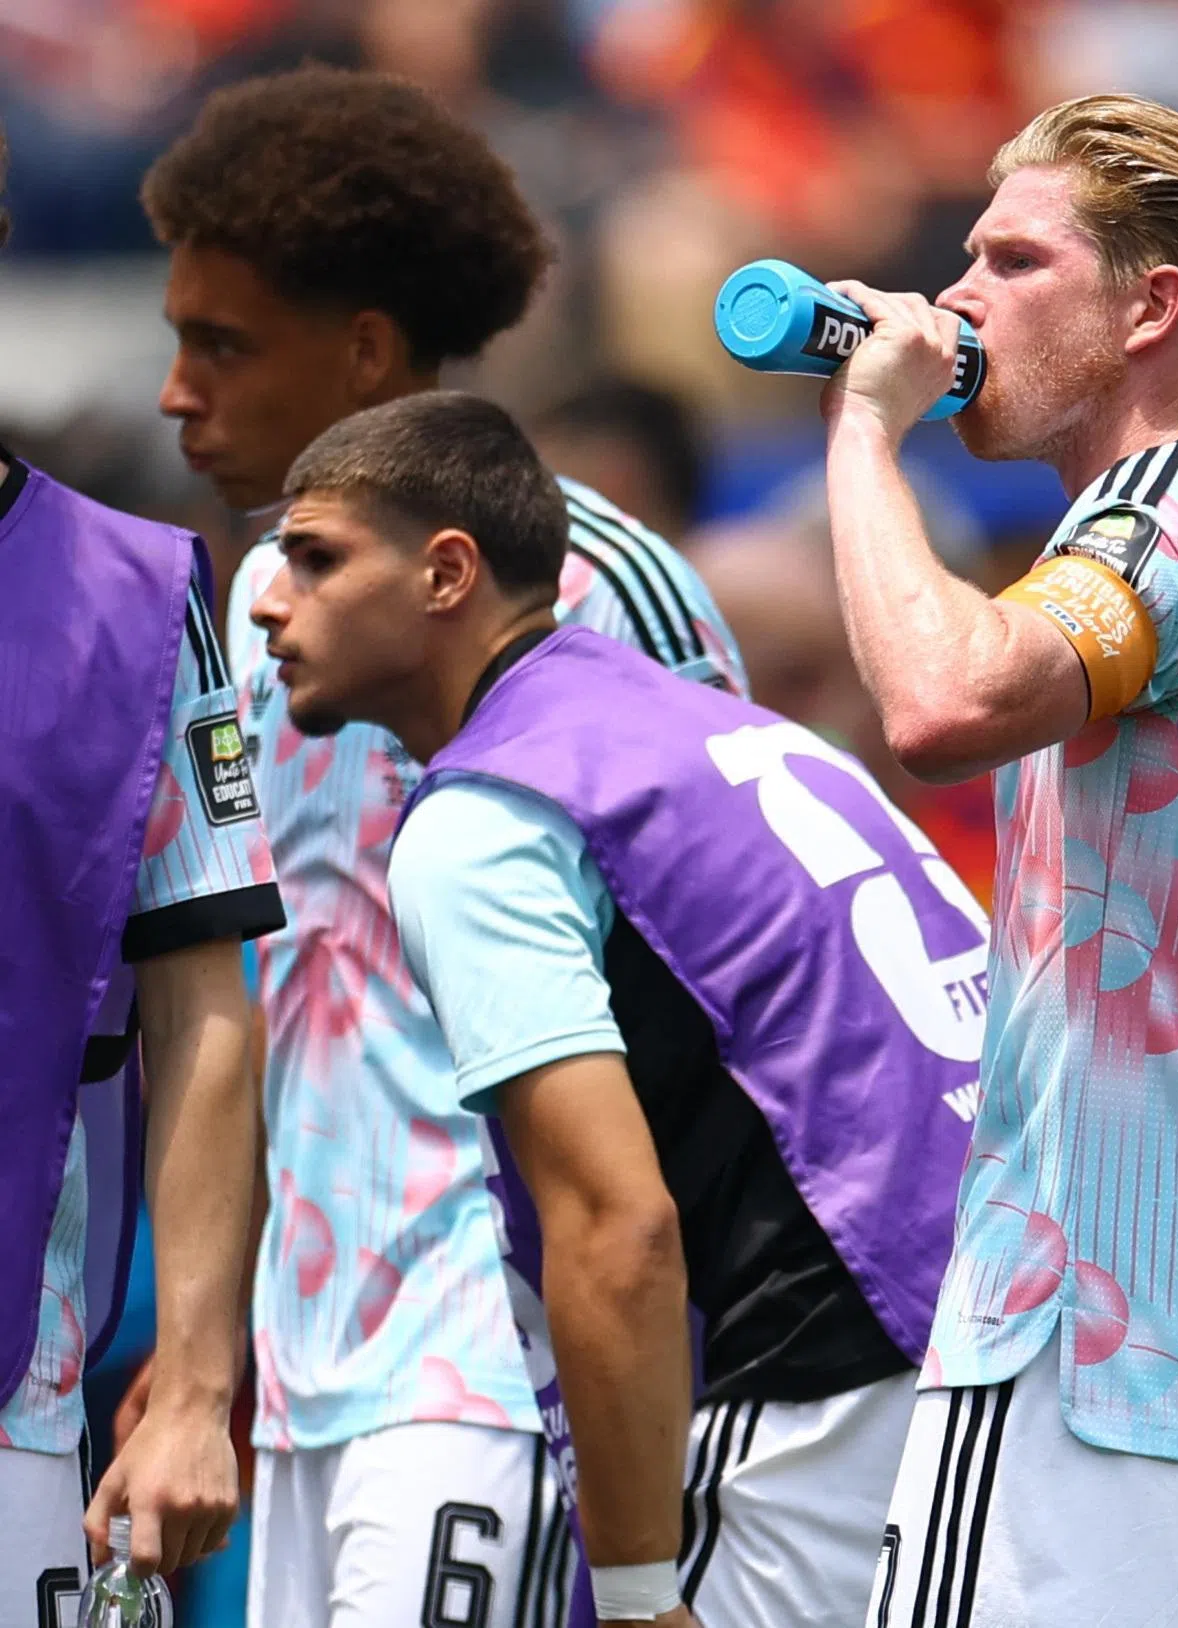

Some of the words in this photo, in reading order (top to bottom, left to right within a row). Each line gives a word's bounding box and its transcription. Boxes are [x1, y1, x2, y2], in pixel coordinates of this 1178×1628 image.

[1044, 601, 1079, 631] FIFA
[944, 971, 988, 1022] FIF
[420, 1501, 504, 1628] 6
